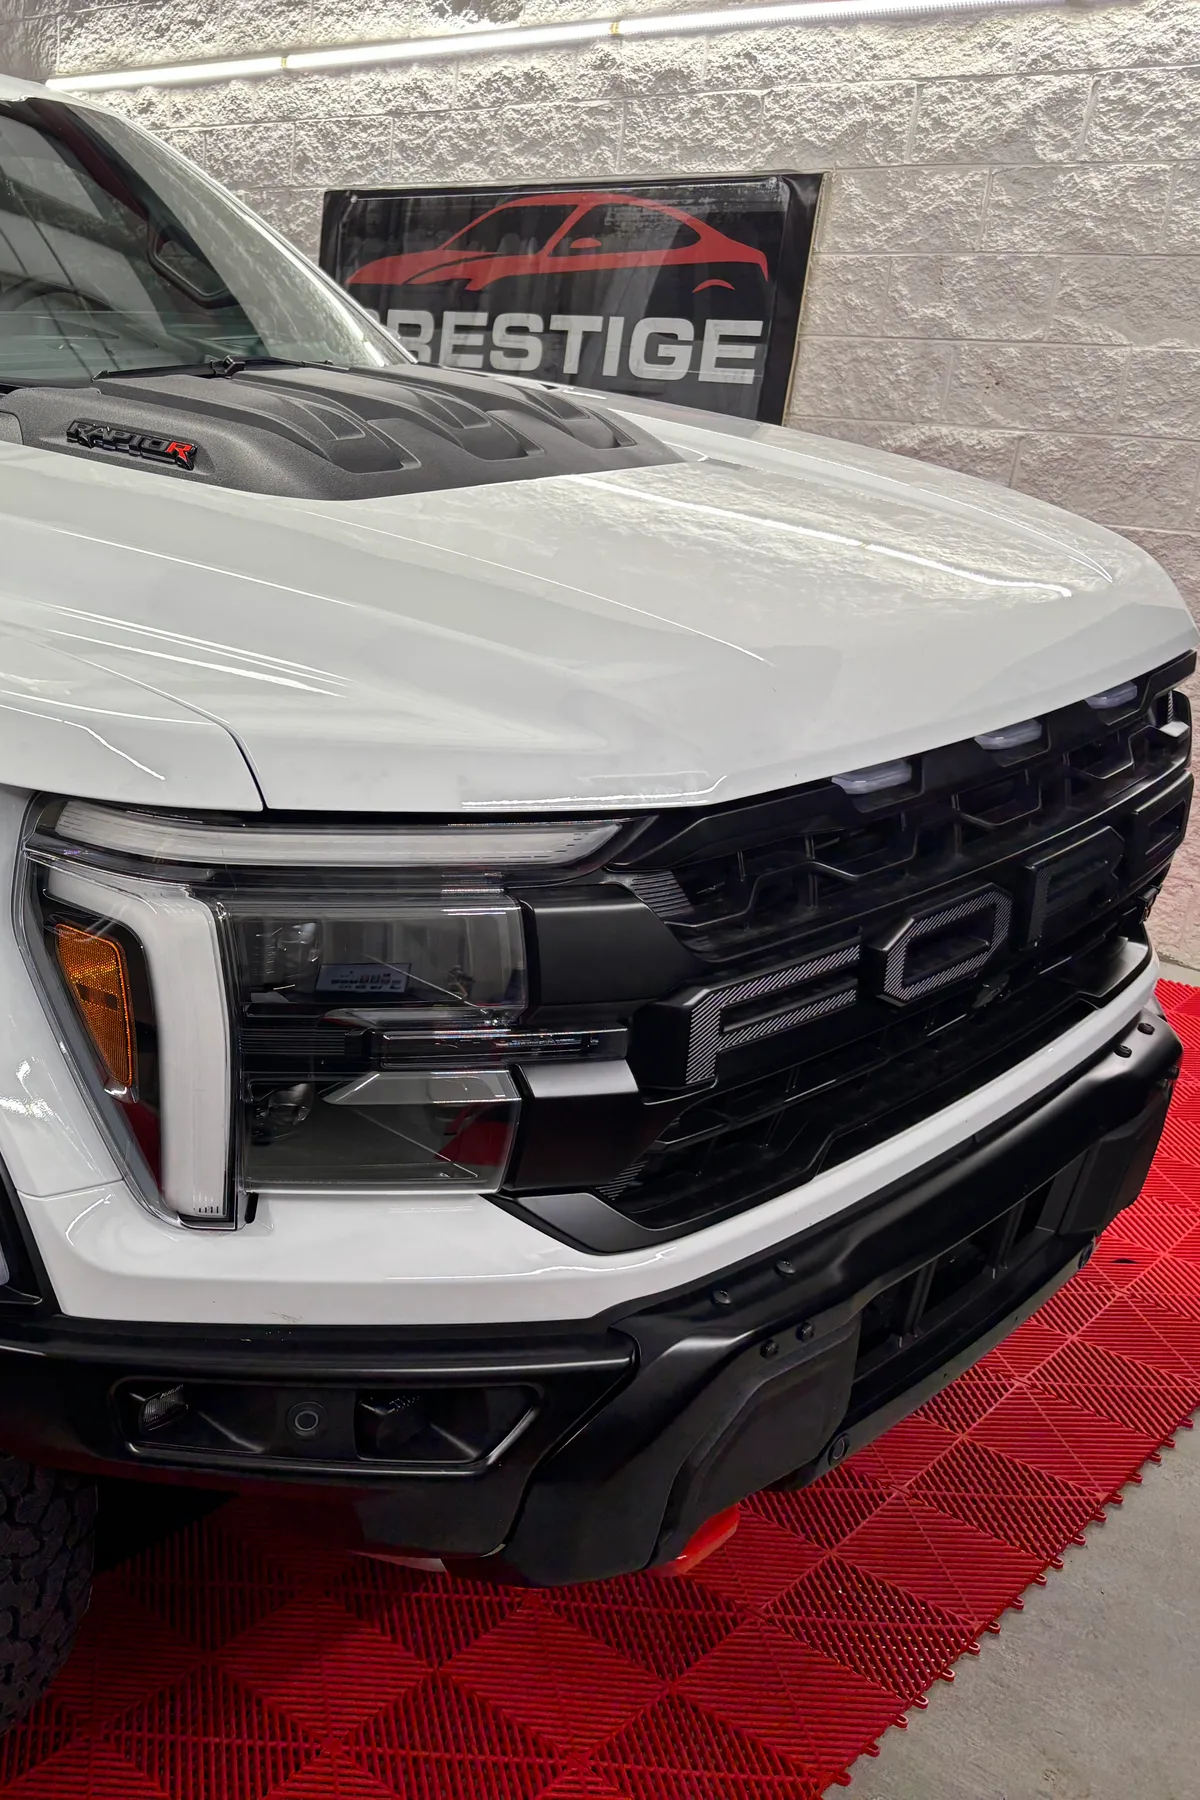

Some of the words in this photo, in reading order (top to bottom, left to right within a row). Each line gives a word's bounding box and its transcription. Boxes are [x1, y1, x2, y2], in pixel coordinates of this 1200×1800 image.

[364, 308, 764, 386] RESTIGE
[66, 419, 197, 471] RAPTOR
[632, 768, 1194, 1090] FORD
